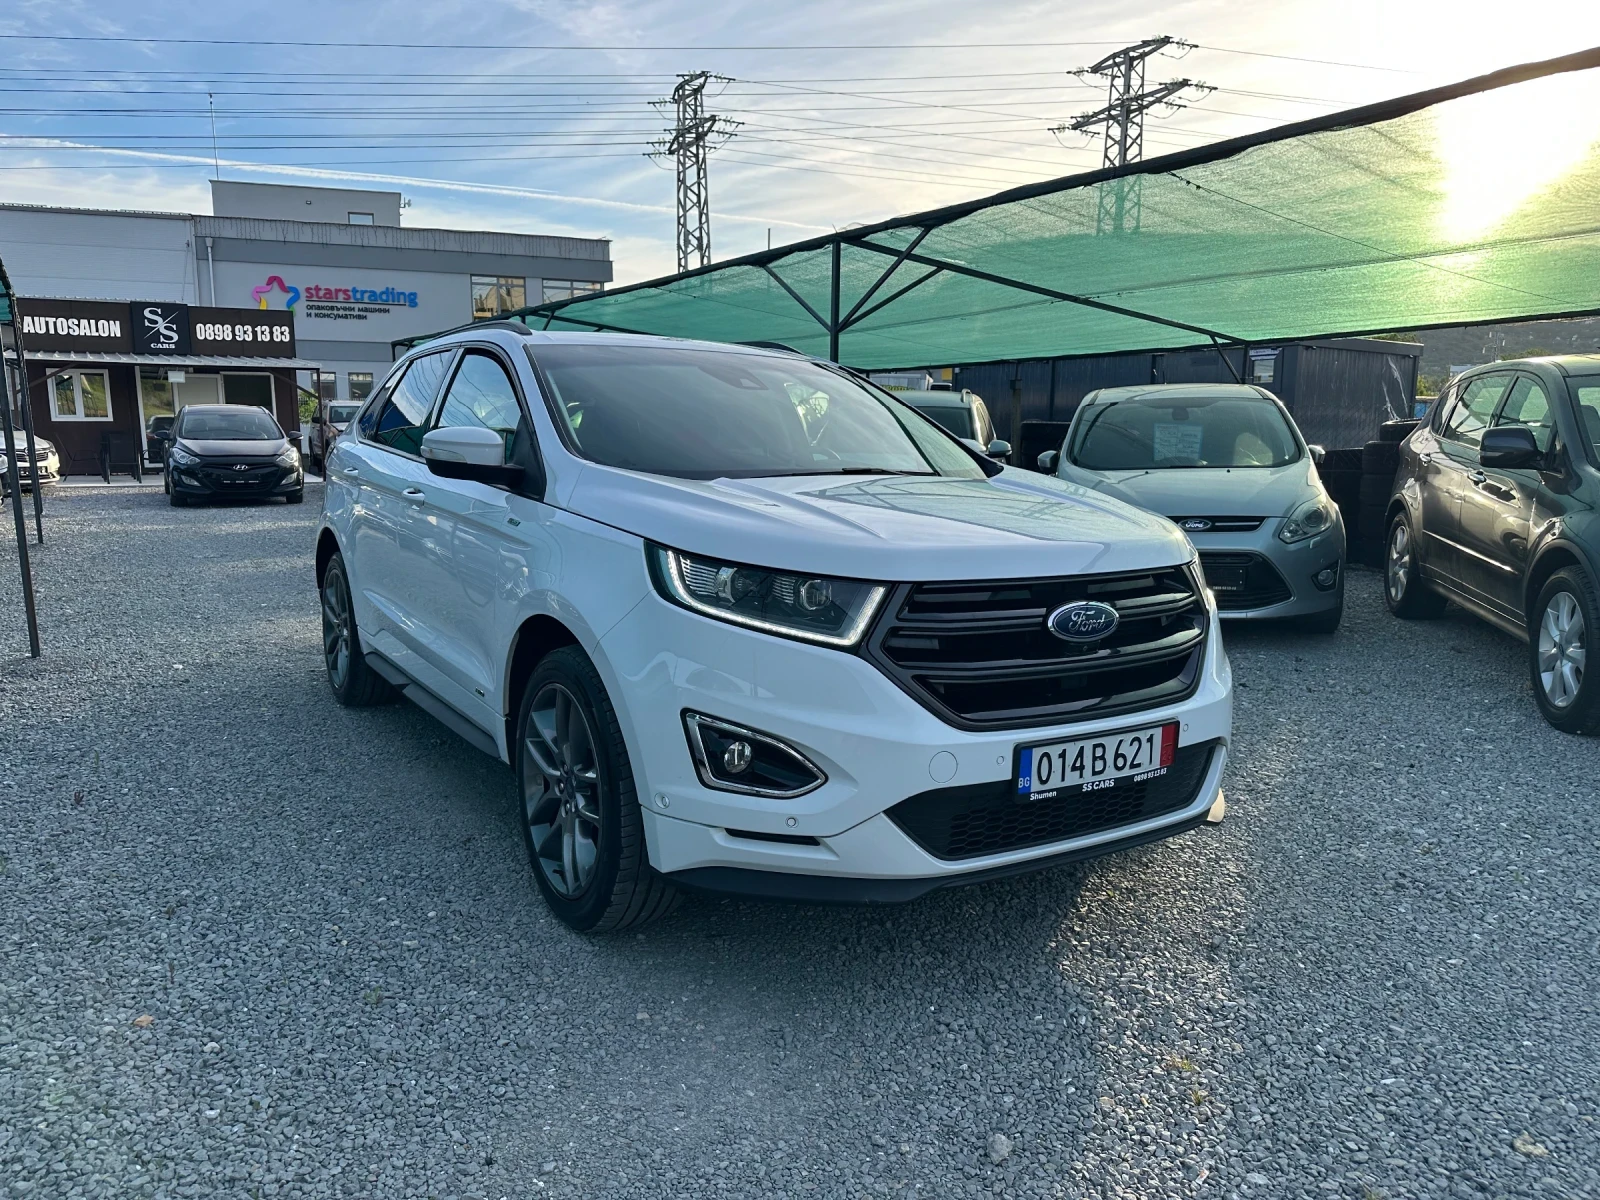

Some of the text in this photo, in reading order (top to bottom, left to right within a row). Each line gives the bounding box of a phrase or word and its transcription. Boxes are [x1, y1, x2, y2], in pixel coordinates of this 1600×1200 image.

[305, 284, 418, 308] starstrading
[306, 303, 390, 314] опаковъчни машини
[314, 311, 368, 321] консумативи
[22, 315, 122, 338] AUTOSALON
[195, 323, 290, 343] 0898 93 13 83
[1068, 609, 1108, 632] Ford
[1036, 733, 1155, 786] 014B621
[1018, 776, 1030, 788] BG
[1093, 778, 1115, 790] CARS
[1029, 790, 1057, 801] Shumen
